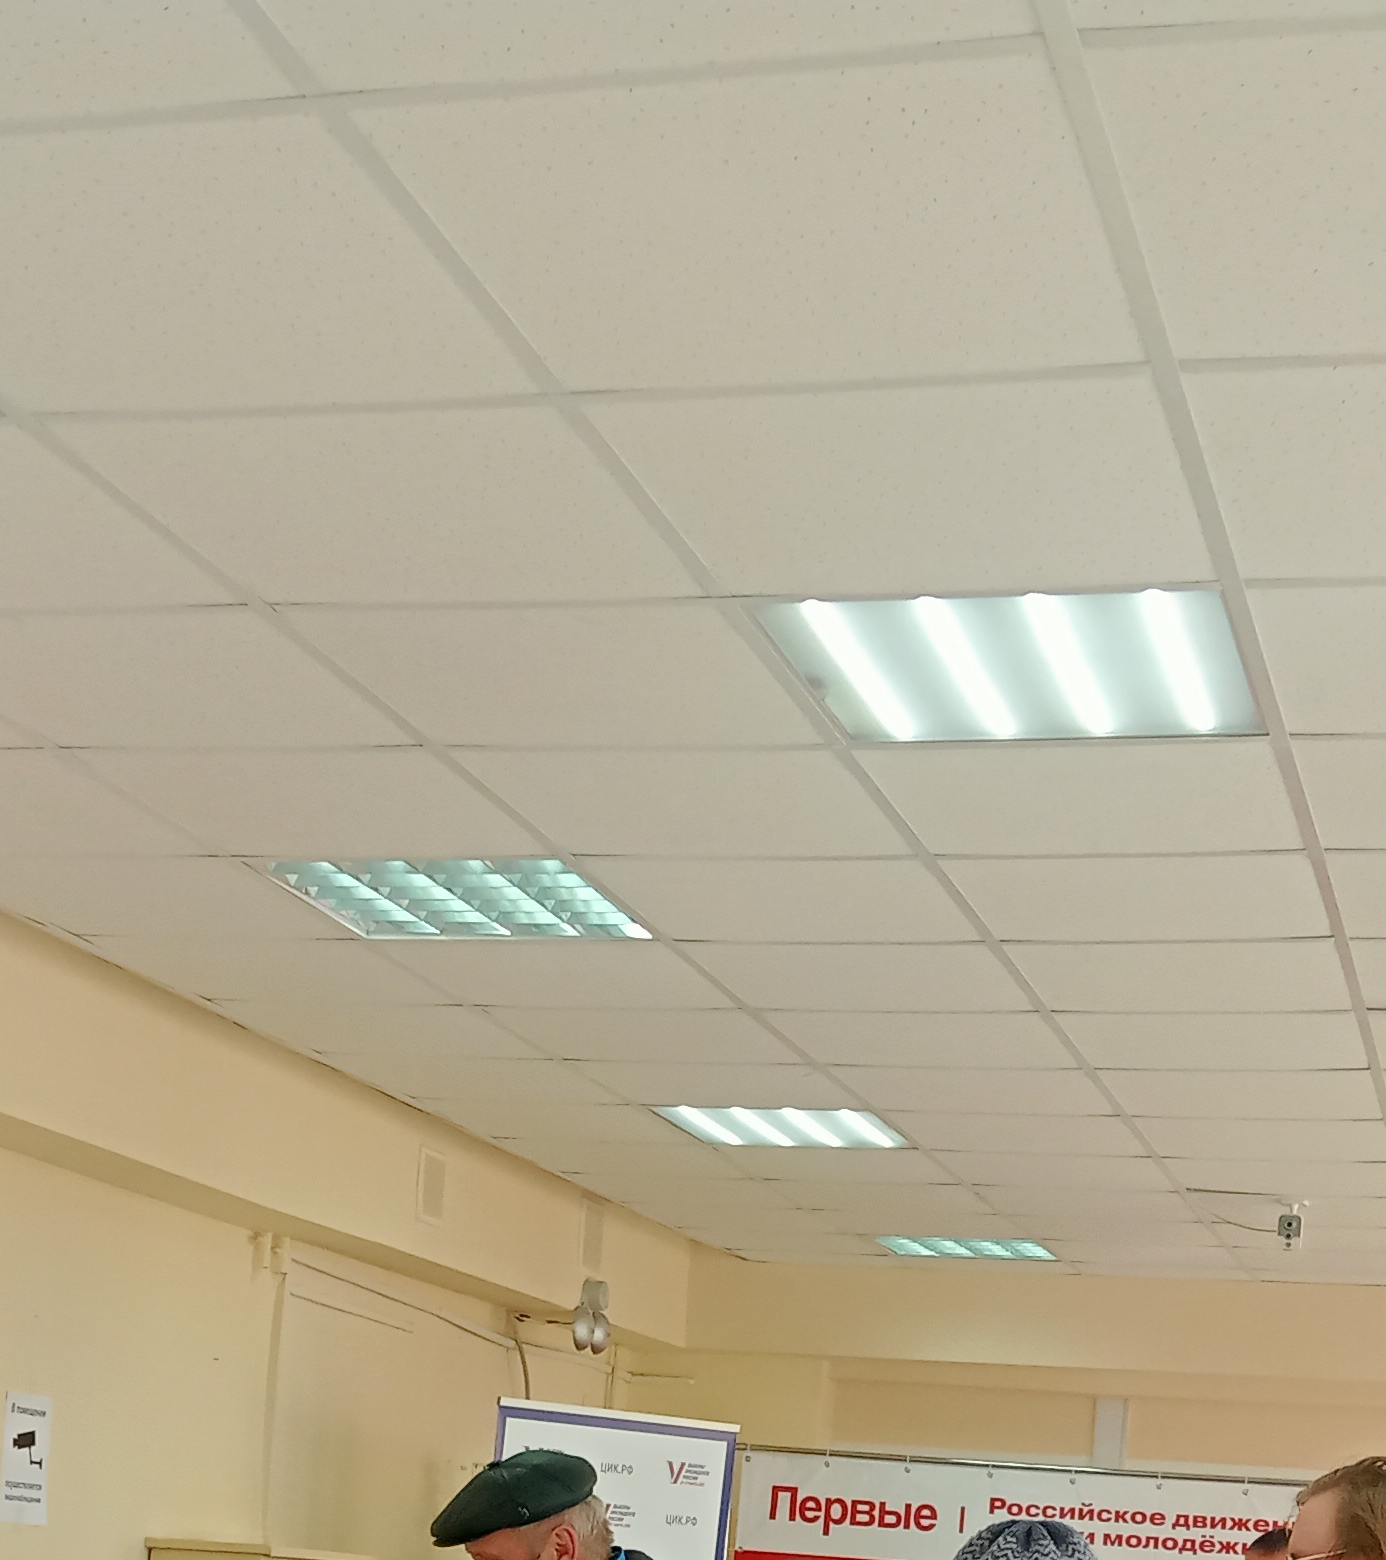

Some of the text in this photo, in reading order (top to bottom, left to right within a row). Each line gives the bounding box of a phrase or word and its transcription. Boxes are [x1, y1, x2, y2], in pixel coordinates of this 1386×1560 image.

[600, 1462, 634, 1476] ЦИК.РФ
[665, 1514, 699, 1527] ЦИК.РФ
[769, 1485, 938, 1536] Первые
[988, 1497, 1295, 1535] Российское движен
